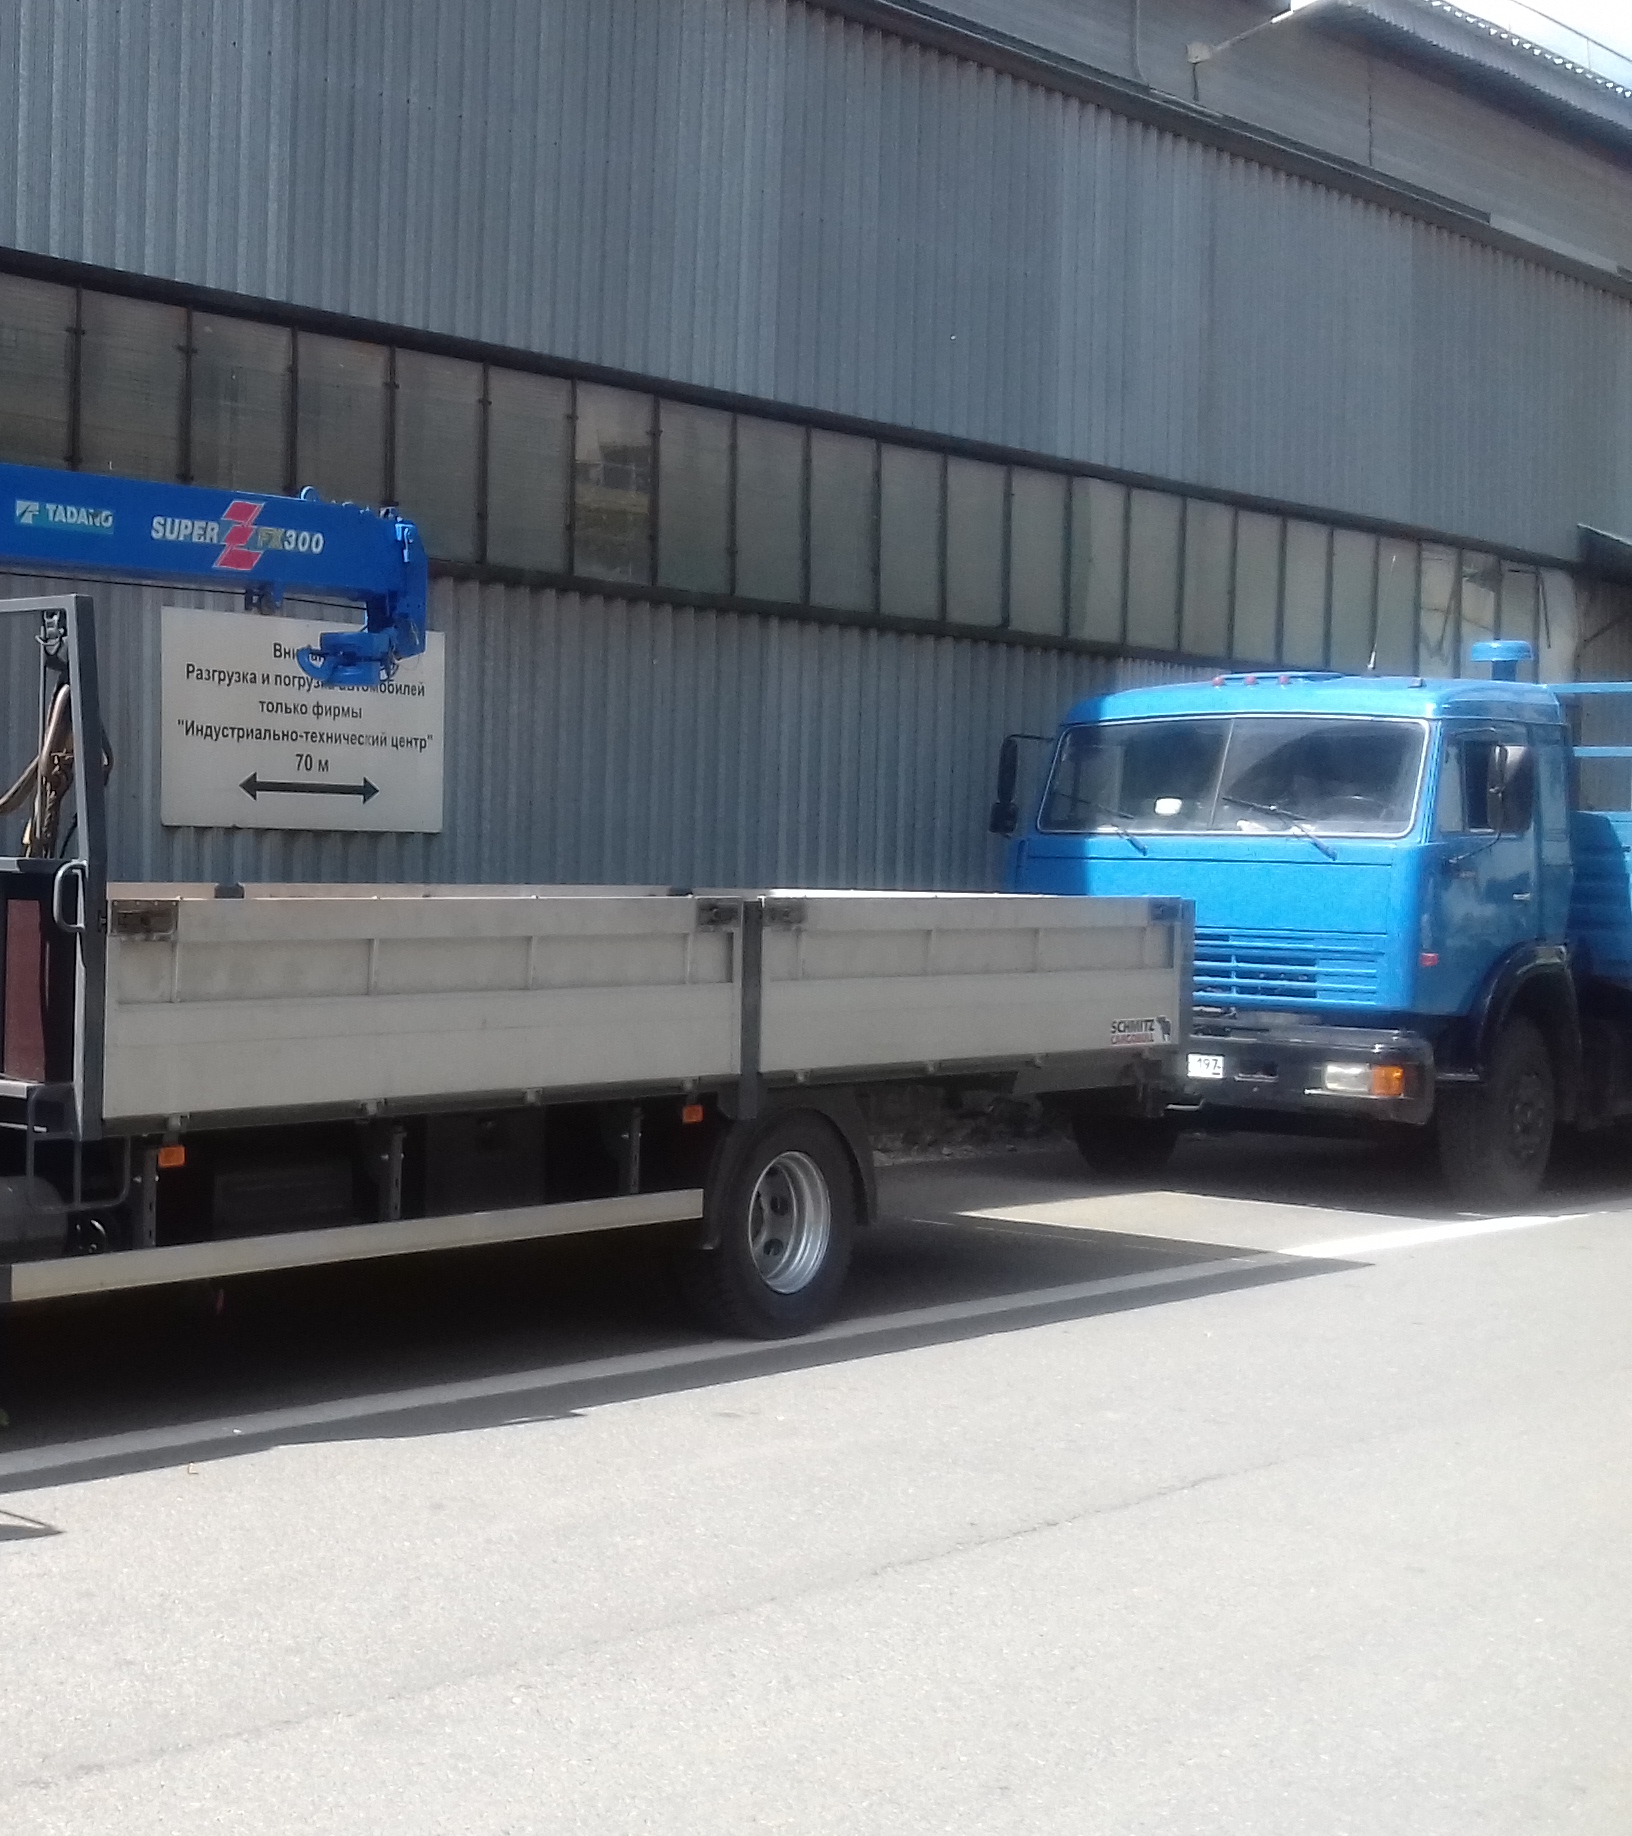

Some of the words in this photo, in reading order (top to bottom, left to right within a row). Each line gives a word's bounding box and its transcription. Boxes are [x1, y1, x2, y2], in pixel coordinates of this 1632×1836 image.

[45, 503, 113, 528] TADANO
[151, 515, 220, 545] SUPER
[185, 663, 258, 691] Разгрузка
[261, 671, 270, 685] и
[274, 674, 336, 693] погруз
[258, 700, 308, 716] только
[312, 701, 363, 720] фирмы
[177, 719, 388, 748] "Индустриально-технический
[390, 735, 434, 753] центр"
[295, 754, 313, 772] 70
[317, 758, 329, 772] м
[1111, 1018, 1155, 1034] SCHMITZ
